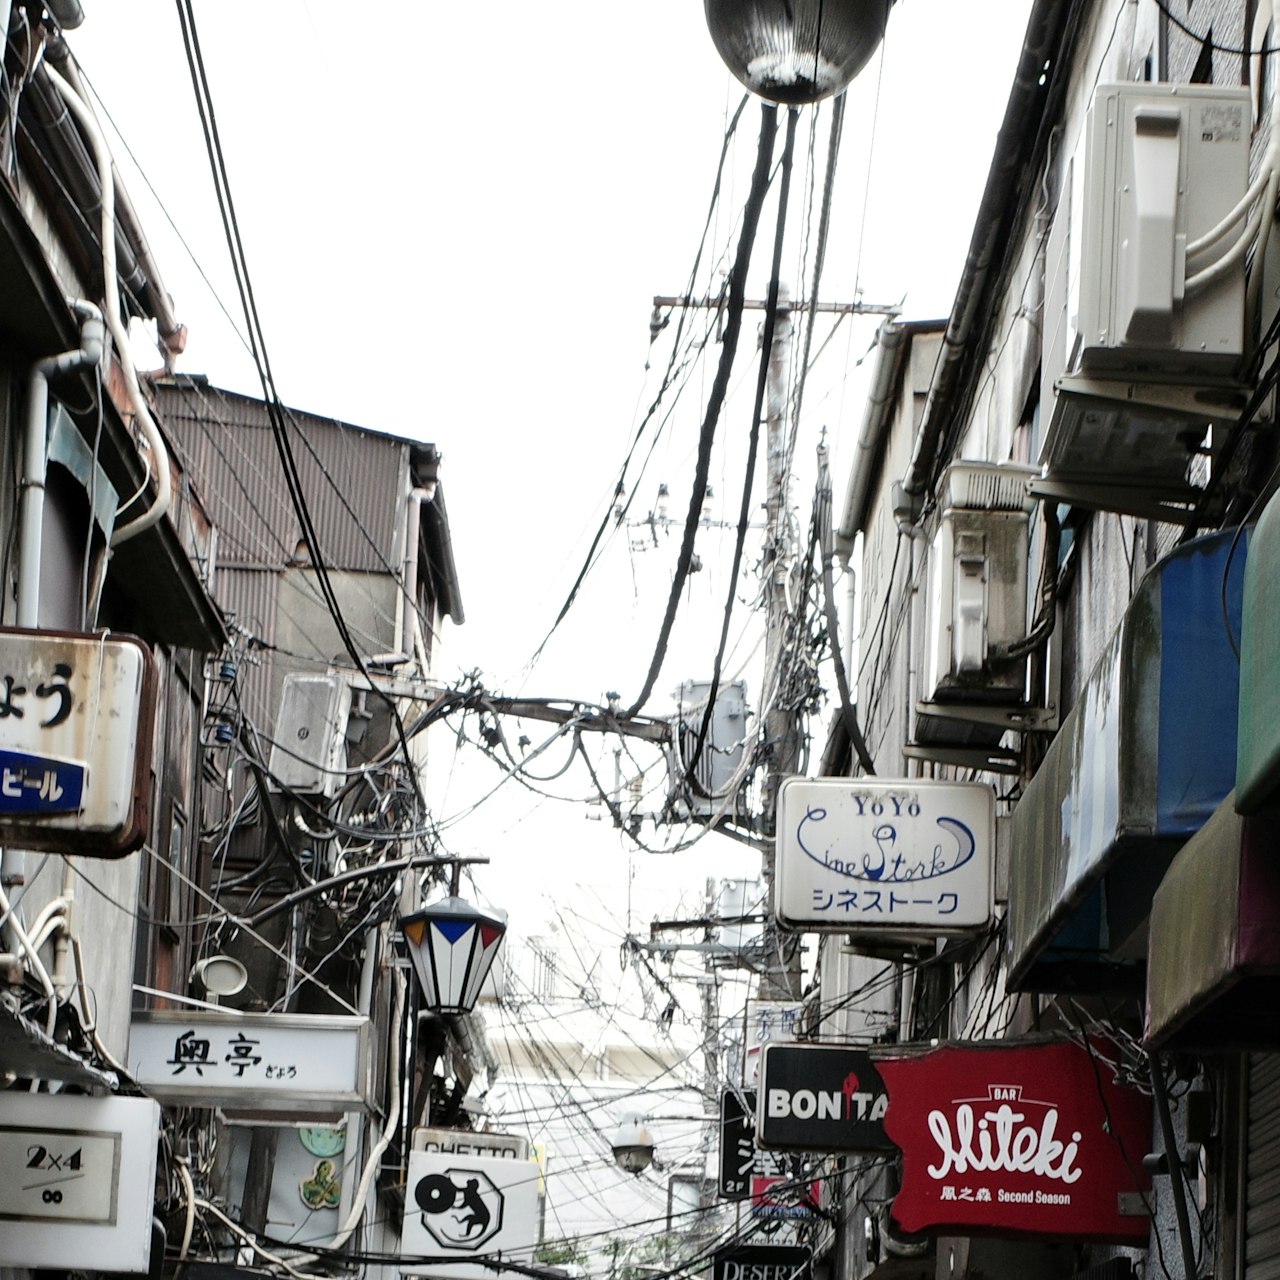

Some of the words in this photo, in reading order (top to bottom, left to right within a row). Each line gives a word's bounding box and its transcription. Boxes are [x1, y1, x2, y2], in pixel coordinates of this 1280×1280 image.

[812, 889, 959, 914] シネストーク
[994, 1088, 1017, 1101] BAR
[927, 1104, 1082, 1184] Miteki
[726, 1181, 744, 1193] 2F
[997, 1188, 1033, 1204] Second
[1035, 1190, 1070, 1205] Season
